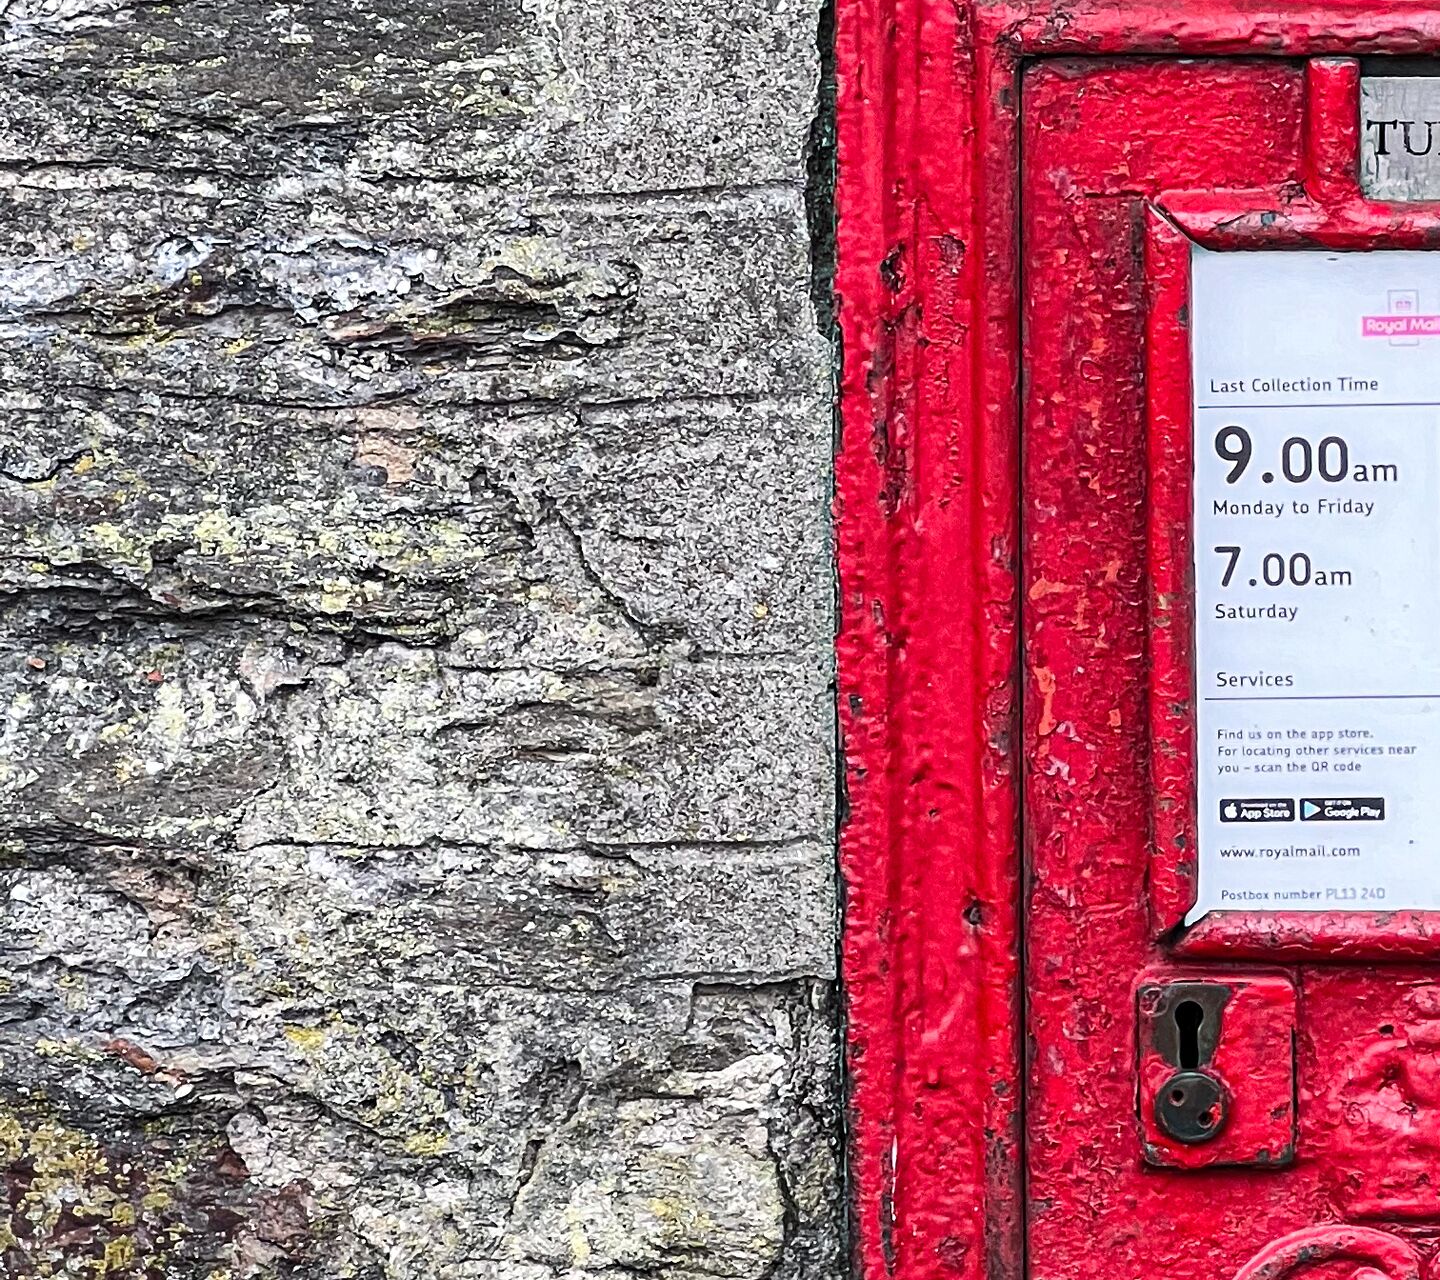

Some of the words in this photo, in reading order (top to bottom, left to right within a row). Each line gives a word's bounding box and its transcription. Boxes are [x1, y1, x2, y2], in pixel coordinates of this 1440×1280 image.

[1366, 318, 1408, 335] Royal
[1210, 378, 1246, 393] Last
[1252, 377, 1332, 392] Collection
[1337, 376, 1379, 391] Time
[1214, 425, 1398, 484] 9.00am
[1213, 499, 1285, 518] Monday
[1292, 501, 1310, 514] to
[1318, 498, 1375, 517] Friday
[1214, 546, 1352, 587] 7.00am
[1215, 603, 1298, 621] Saturday
[1216, 670, 1294, 687] Services
[1217, 729, 1243, 740] Find
[1248, 731, 1262, 739] us
[1267, 731, 1282, 739] on
[1287, 729, 1306, 739] the
[1311, 730, 1334, 741] app
[1338, 729, 1374, 739] store.
[1218, 746, 1237, 756] For
[1242, 746, 1291, 758] locating
[1295, 746, 1329, 756] other
[1333, 745, 1384, 755] services
[1388, 745, 1417, 755] near
[1217, 764, 1239, 775] you
[1254, 764, 1282, 773] scan
[1287, 762, 1306, 772] the
[1311, 762, 1329, 772] QR
[1333, 762, 1362, 772] code
[1240, 808, 1261, 819] App
[1263, 808, 1291, 818] Store
[1324, 807, 1359, 819] Google
[1360, 807, 1381, 818] Play
[1220, 845, 1361, 860] www.royalmail.com
[1221, 889, 1269, 900] Postbox
[1274, 889, 1322, 900] number
[1325, 888, 1357, 900] PL13
